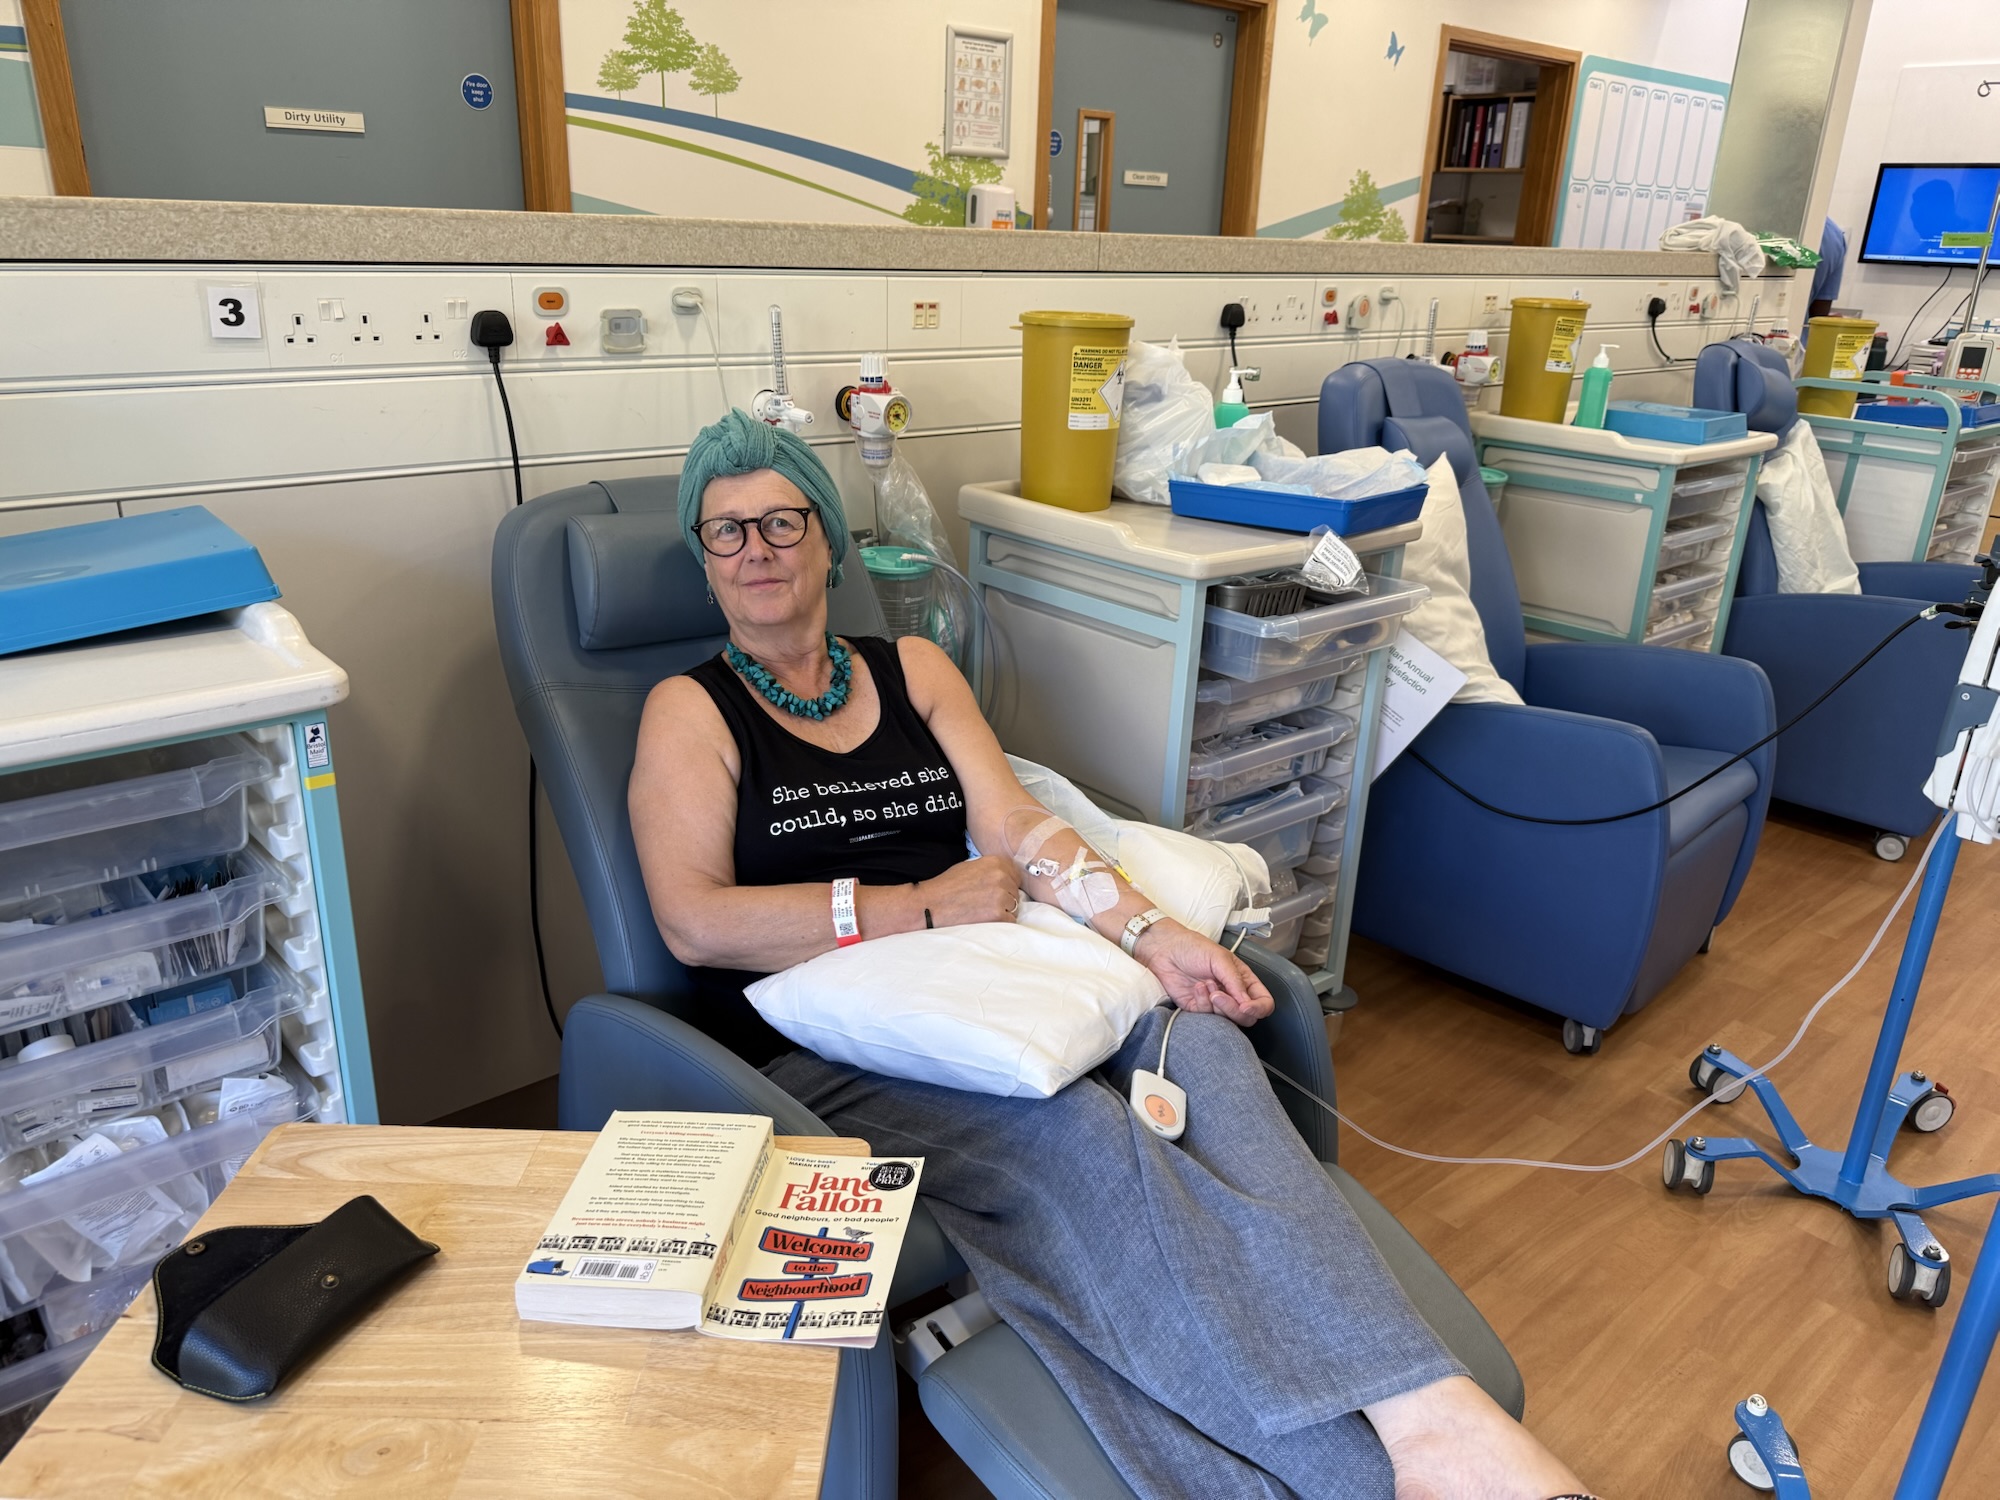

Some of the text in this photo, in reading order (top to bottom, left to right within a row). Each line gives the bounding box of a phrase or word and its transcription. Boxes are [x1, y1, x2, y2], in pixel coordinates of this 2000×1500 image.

[284, 111, 345, 126] Dirty Utility
[218, 298, 245, 327] 3
[1384, 676, 1397, 688] ey
[1387, 658, 1427, 695] atisfaction
[1404, 657, 1434, 684] Annual
[772, 766, 949, 804] She believed she
[770, 792, 962, 836] could, so she did.
[802, 1172, 878, 1196] Jane
[778, 1183, 883, 1213] Fallon
[755, 1209, 779, 1218] Good
[781, 1213, 831, 1222] neighbours,
[772, 1233, 866, 1258] Welcome
[809, 1264, 828, 1272] the
[746, 1278, 863, 1298] Neighbourhood
